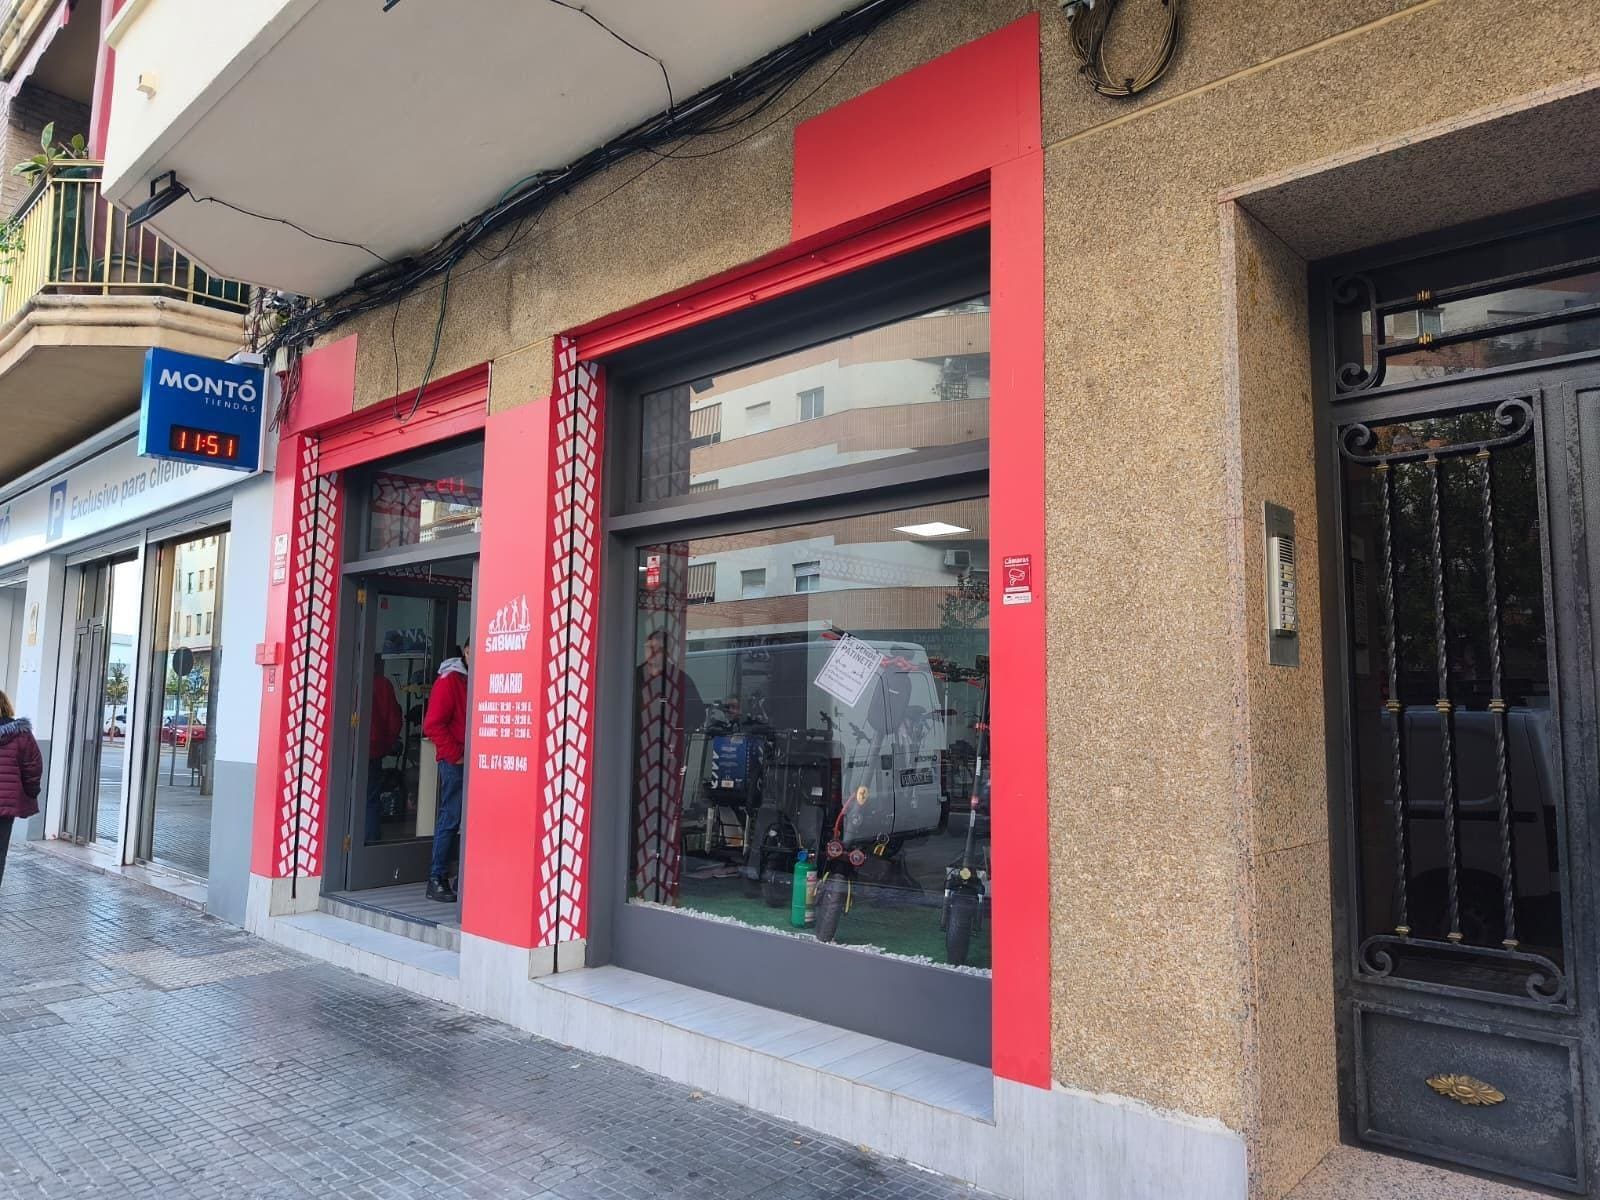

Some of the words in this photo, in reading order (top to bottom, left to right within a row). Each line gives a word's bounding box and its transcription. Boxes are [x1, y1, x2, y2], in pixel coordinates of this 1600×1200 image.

[158, 368, 257, 402] MONTÓ
[204, 397, 256, 413] TIENDAS
[180, 431, 233, 457] 11:51
[70, 483, 119, 521] Exclusivo
[121, 471, 147, 507] para
[150, 458, 199, 489] cliente
[485, 632, 528, 653] SABWAY
[840, 645, 874, 669] PATINETE
[488, 672, 523, 694] HORARIO
[478, 754, 490, 769] TEL.
